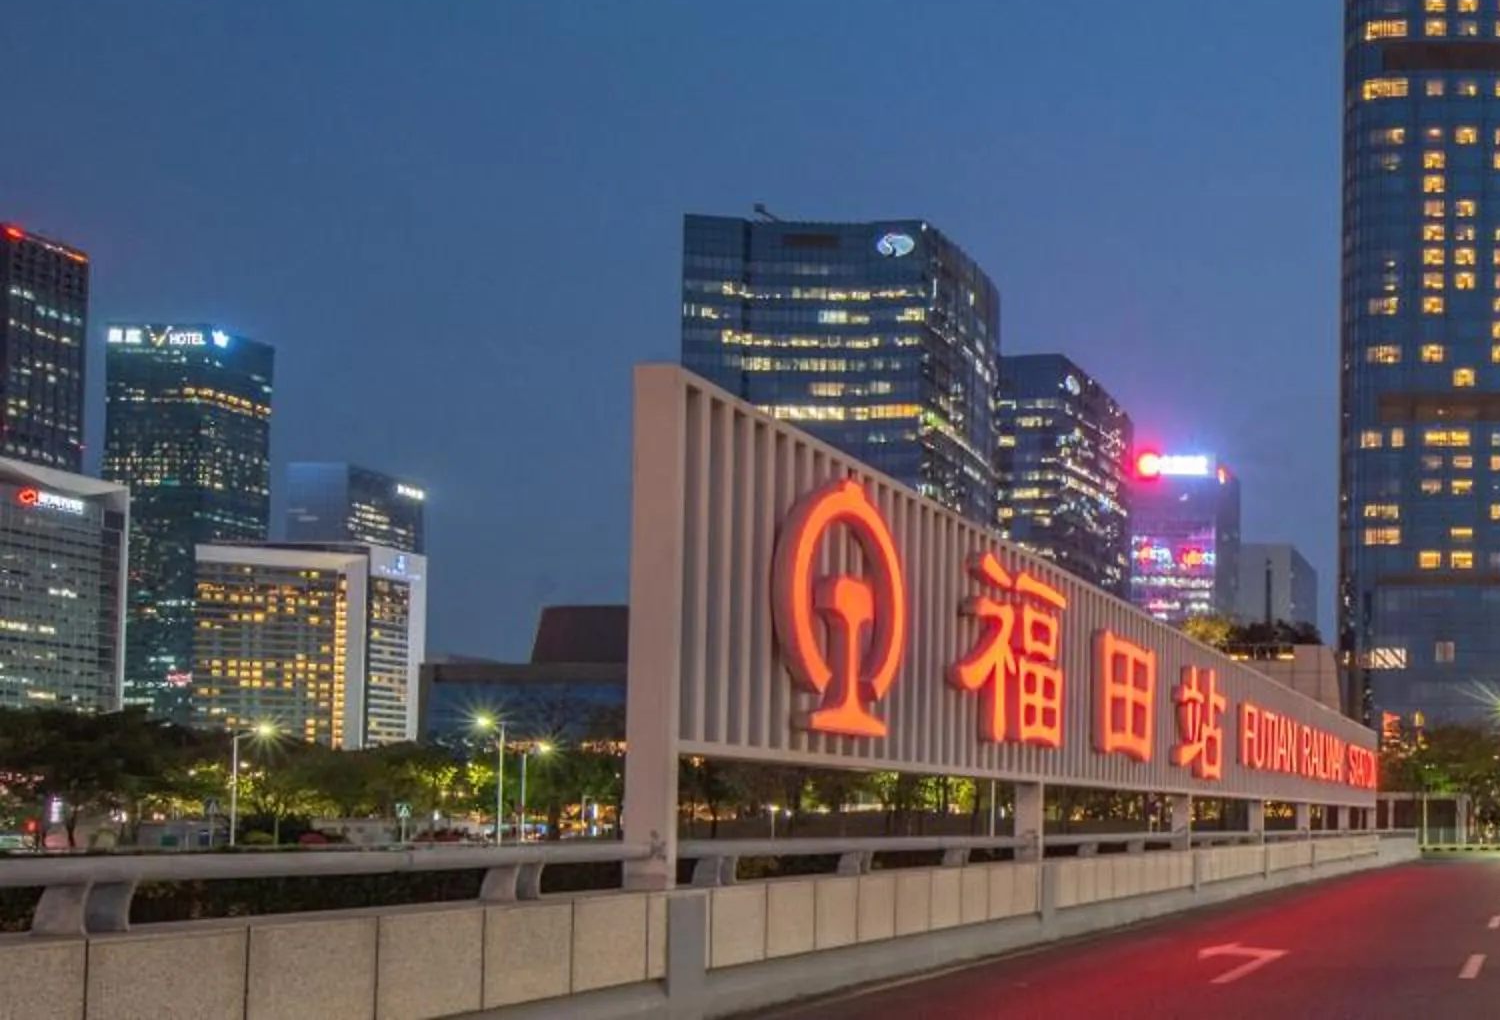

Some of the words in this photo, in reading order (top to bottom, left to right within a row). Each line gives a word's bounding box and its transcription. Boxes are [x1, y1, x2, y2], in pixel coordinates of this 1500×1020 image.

[169, 331, 206, 345] HOTEL
[957, 552, 1227, 778] 福田站
[1241, 702, 1298, 773] FUTIAN
